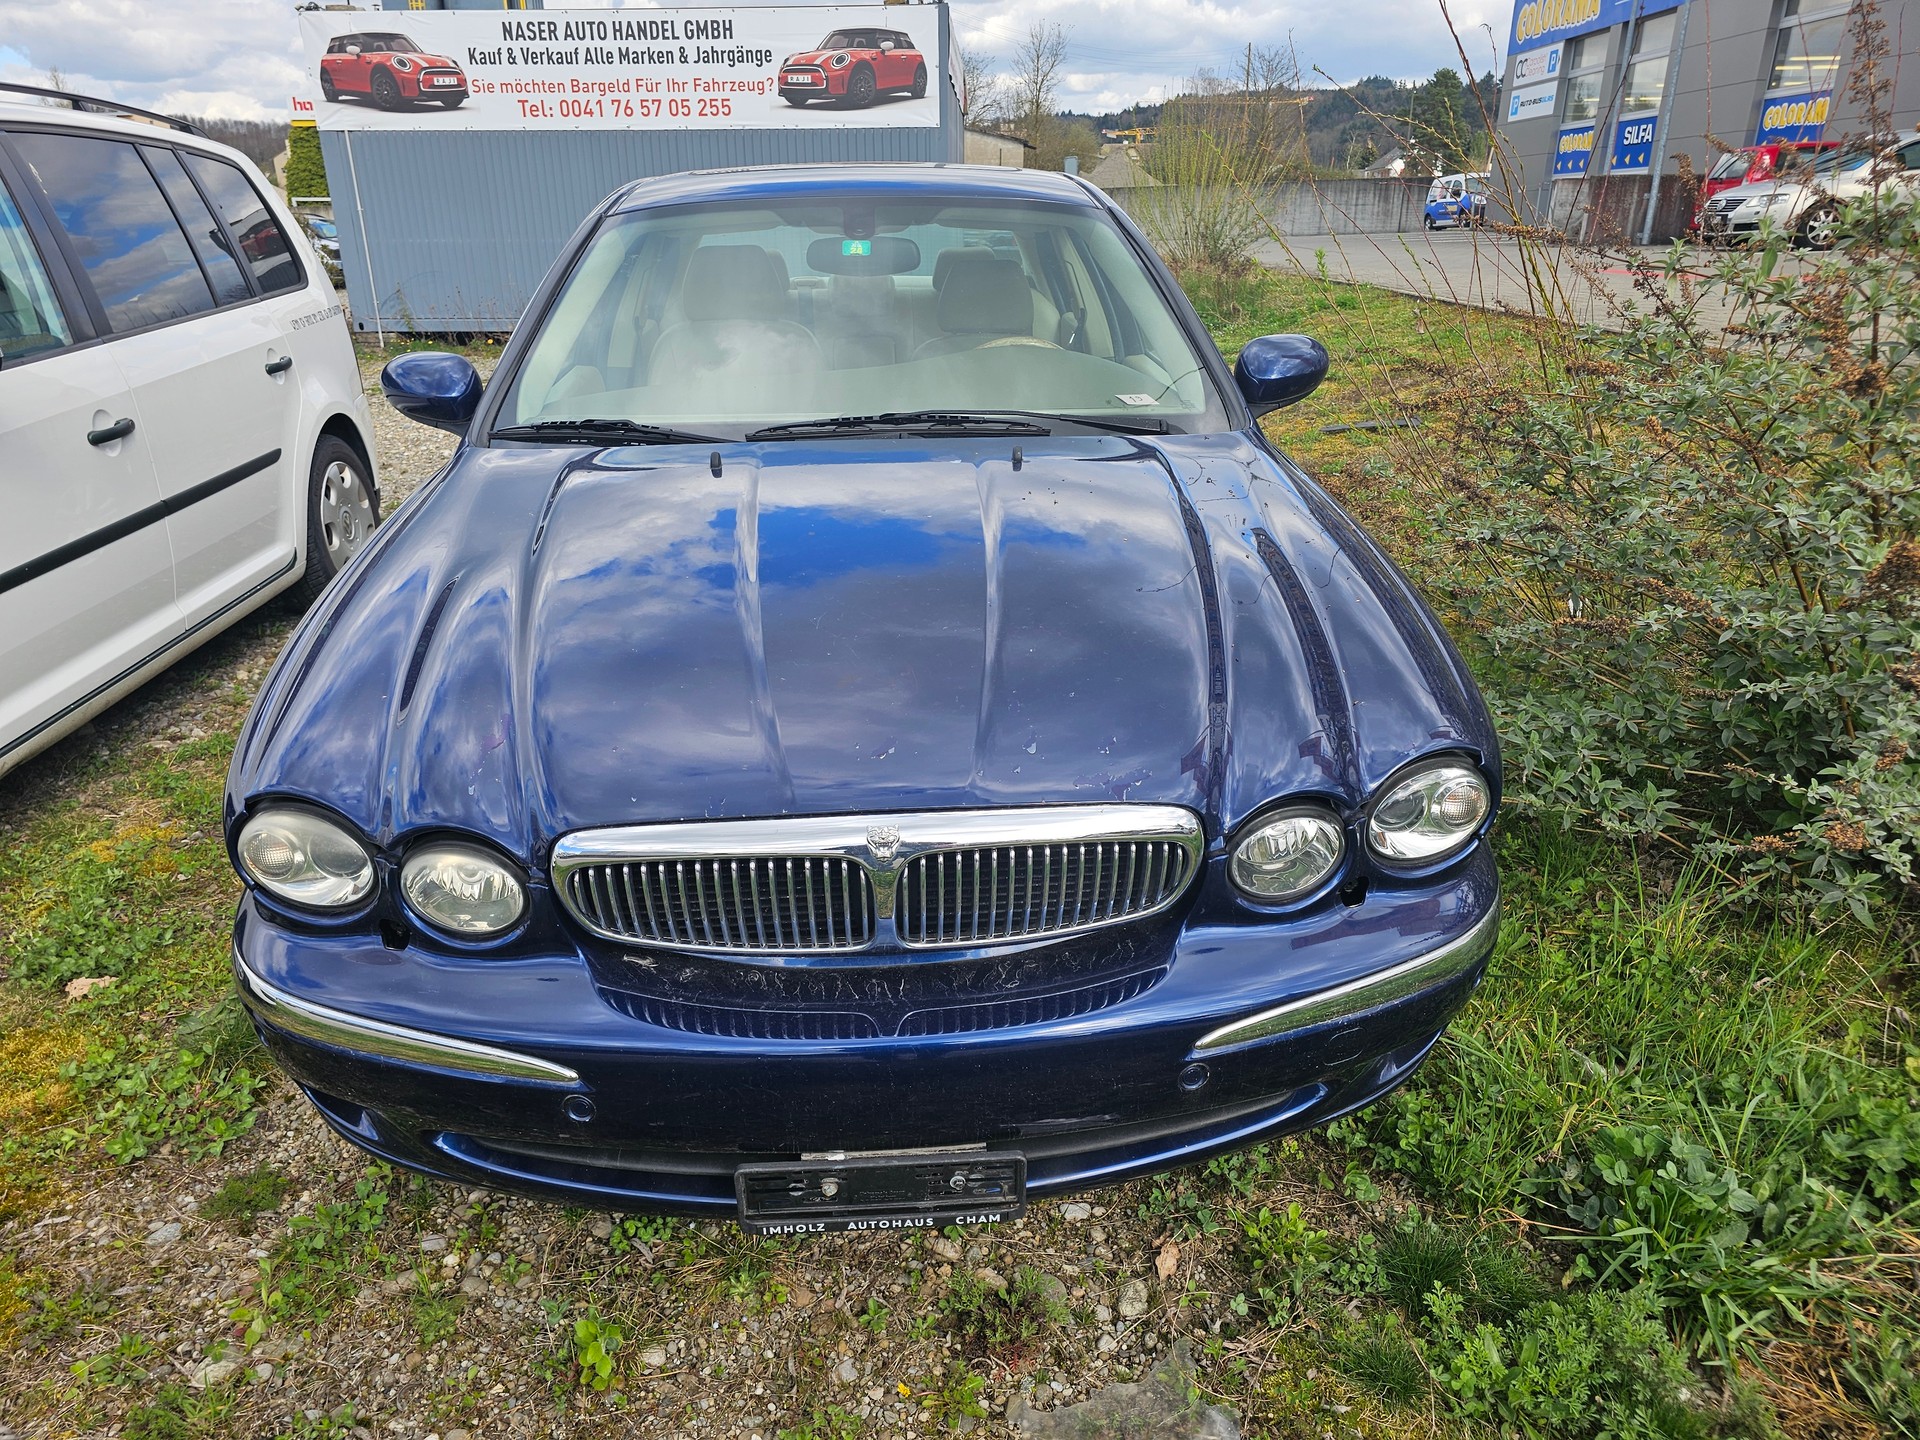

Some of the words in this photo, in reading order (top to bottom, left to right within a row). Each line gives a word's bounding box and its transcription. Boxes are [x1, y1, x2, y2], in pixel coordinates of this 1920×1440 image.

[502, 21, 559, 41] NASER
[564, 21, 608, 41] AUTO
[612, 20, 680, 41] HANDEL
[684, 19, 734, 40] GMBH
[467, 47, 502, 65] Kauf
[507, 47, 518, 65] &
[520, 47, 579, 65] Verkauf
[584, 47, 614, 65] Alle
[618, 46, 675, 65] Marken
[679, 46, 689, 64] &
[693, 45, 773, 68] Jahrgänge
[471, 79, 495, 93] Sie
[500, 79, 566, 93] möchten
[570, 78, 631, 97] Bargeld
[635, 78, 661, 93] Für
[666, 78, 688, 93] Ihr
[693, 77, 774, 95] Fahrzeug?
[517, 99, 554, 117] Tel:
[559, 99, 604, 117] 0041
[611, 99, 634, 117] 76
[640, 99, 662, 117] 57
[668, 98, 691, 117] 05
[697, 98, 732, 116] 255
[1623, 123, 1653, 145] SILFA
[762, 1223, 825, 1235] IMHOLZ
[847, 1218, 934, 1230] AUTOHAUS
[955, 1214, 1001, 1225] CHAM
